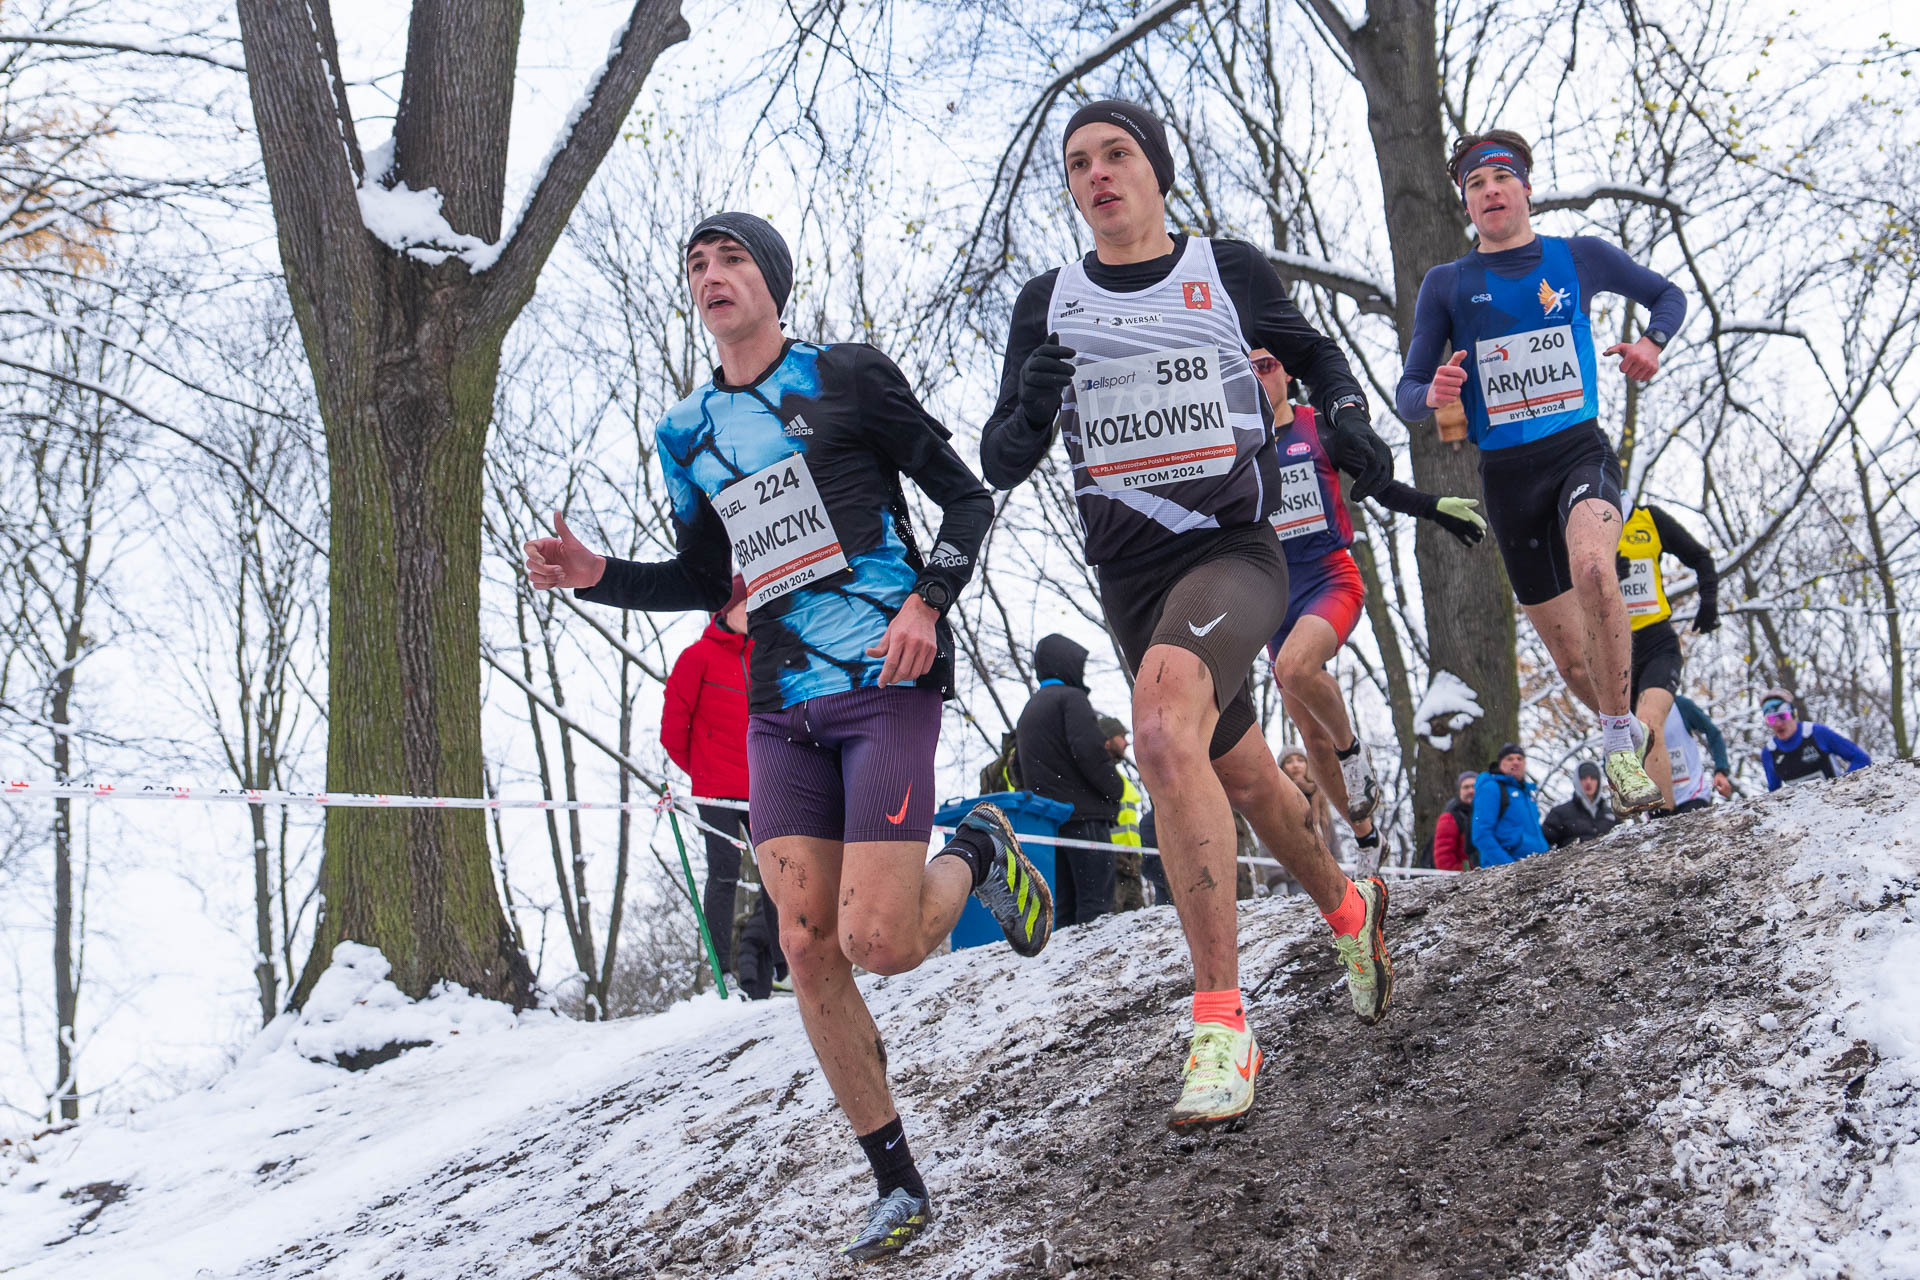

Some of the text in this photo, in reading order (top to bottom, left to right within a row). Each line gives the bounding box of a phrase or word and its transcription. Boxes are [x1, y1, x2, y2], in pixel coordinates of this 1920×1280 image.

[1471, 293, 1493, 304] esa
[1060, 306, 1084, 319] erima
[1124, 314, 1160, 326] WERSAL
[1528, 332, 1565, 353] 260
[1083, 370, 1137, 392] Bellsport
[1156, 356, 1208, 386] 588
[1487, 361, 1577, 396] ARMUŁA
[1542, 402, 1563, 414] 2024
[777, 427, 814, 438] adidas
[1084, 400, 1226, 450] KOZŁOWSKI
[754, 466, 800, 505] 224
[1123, 464, 1205, 487] BYTOM 2024
[733, 504, 826, 569] BRAMCZYK
[790, 568, 816, 587] 2024
